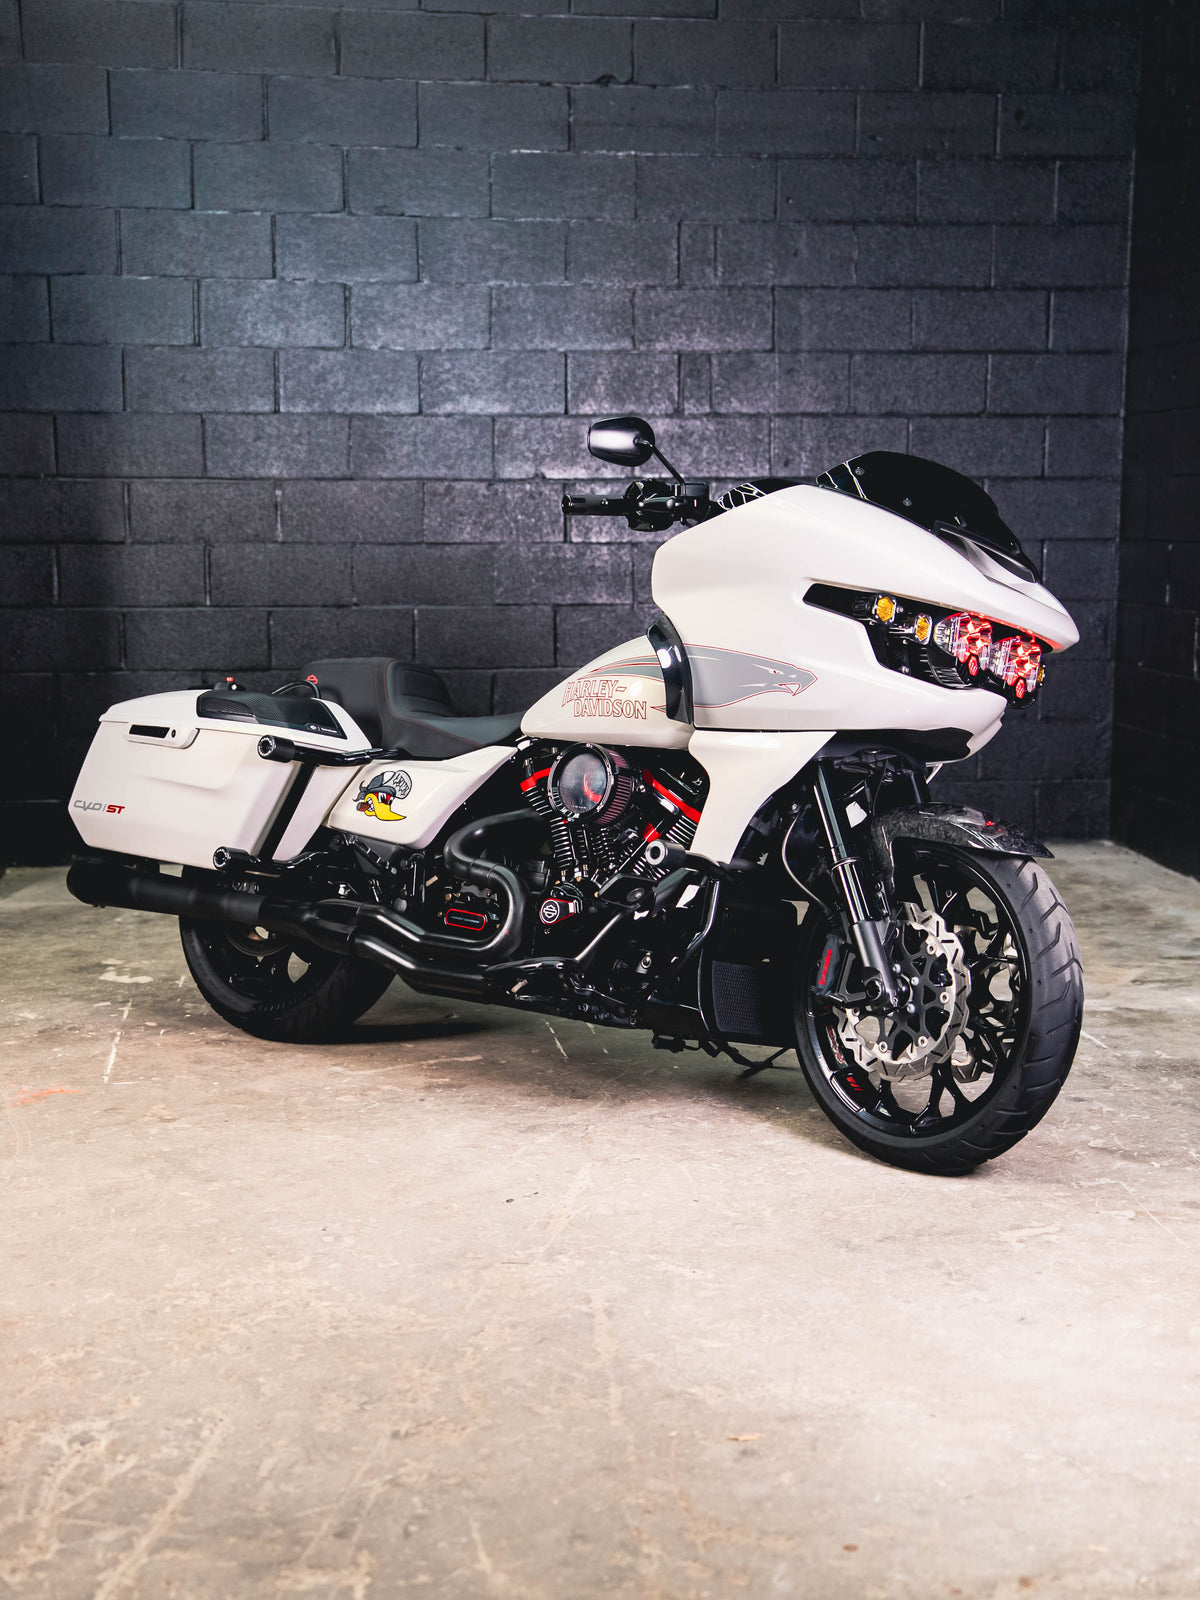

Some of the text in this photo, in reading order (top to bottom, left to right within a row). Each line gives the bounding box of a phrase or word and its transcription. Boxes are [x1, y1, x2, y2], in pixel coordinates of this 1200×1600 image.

[573, 698, 648, 720] DAVIDSON
[106, 804, 125, 814] ST
[818, 949, 833, 985] brembo
